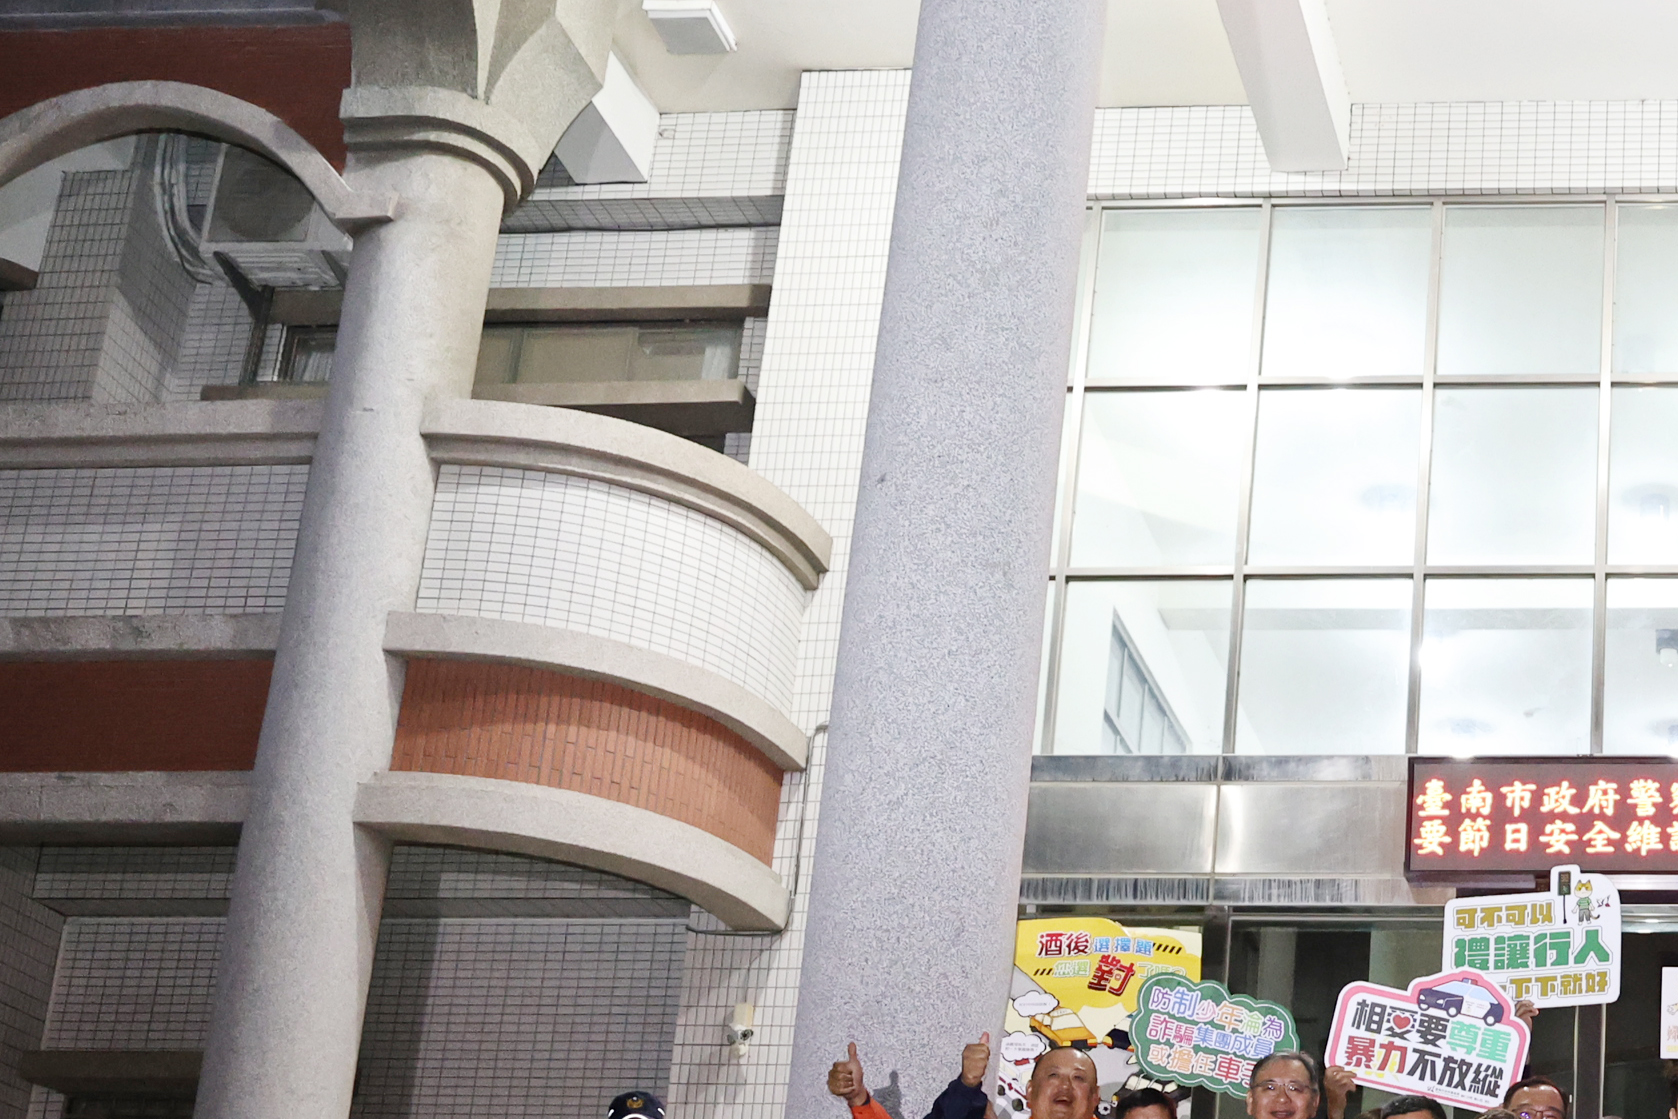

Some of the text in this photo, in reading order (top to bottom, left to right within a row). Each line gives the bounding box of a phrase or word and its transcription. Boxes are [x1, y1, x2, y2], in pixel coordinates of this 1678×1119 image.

[1456, 902, 1553, 929] 可不可以
[1037, 932, 1154, 957] 酒後選擇題
[1454, 929, 1610, 971] 禮讓行人
[1500, 971, 1608, 999] 下下就好
[1150, 987, 1285, 1040] 防制少年淪為
[1352, 999, 1511, 1064] 相愛要尊重
[1147, 1014, 1275, 1060] 詐騙集團成員
[1344, 1035, 1504, 1099] 暴力不放縱
